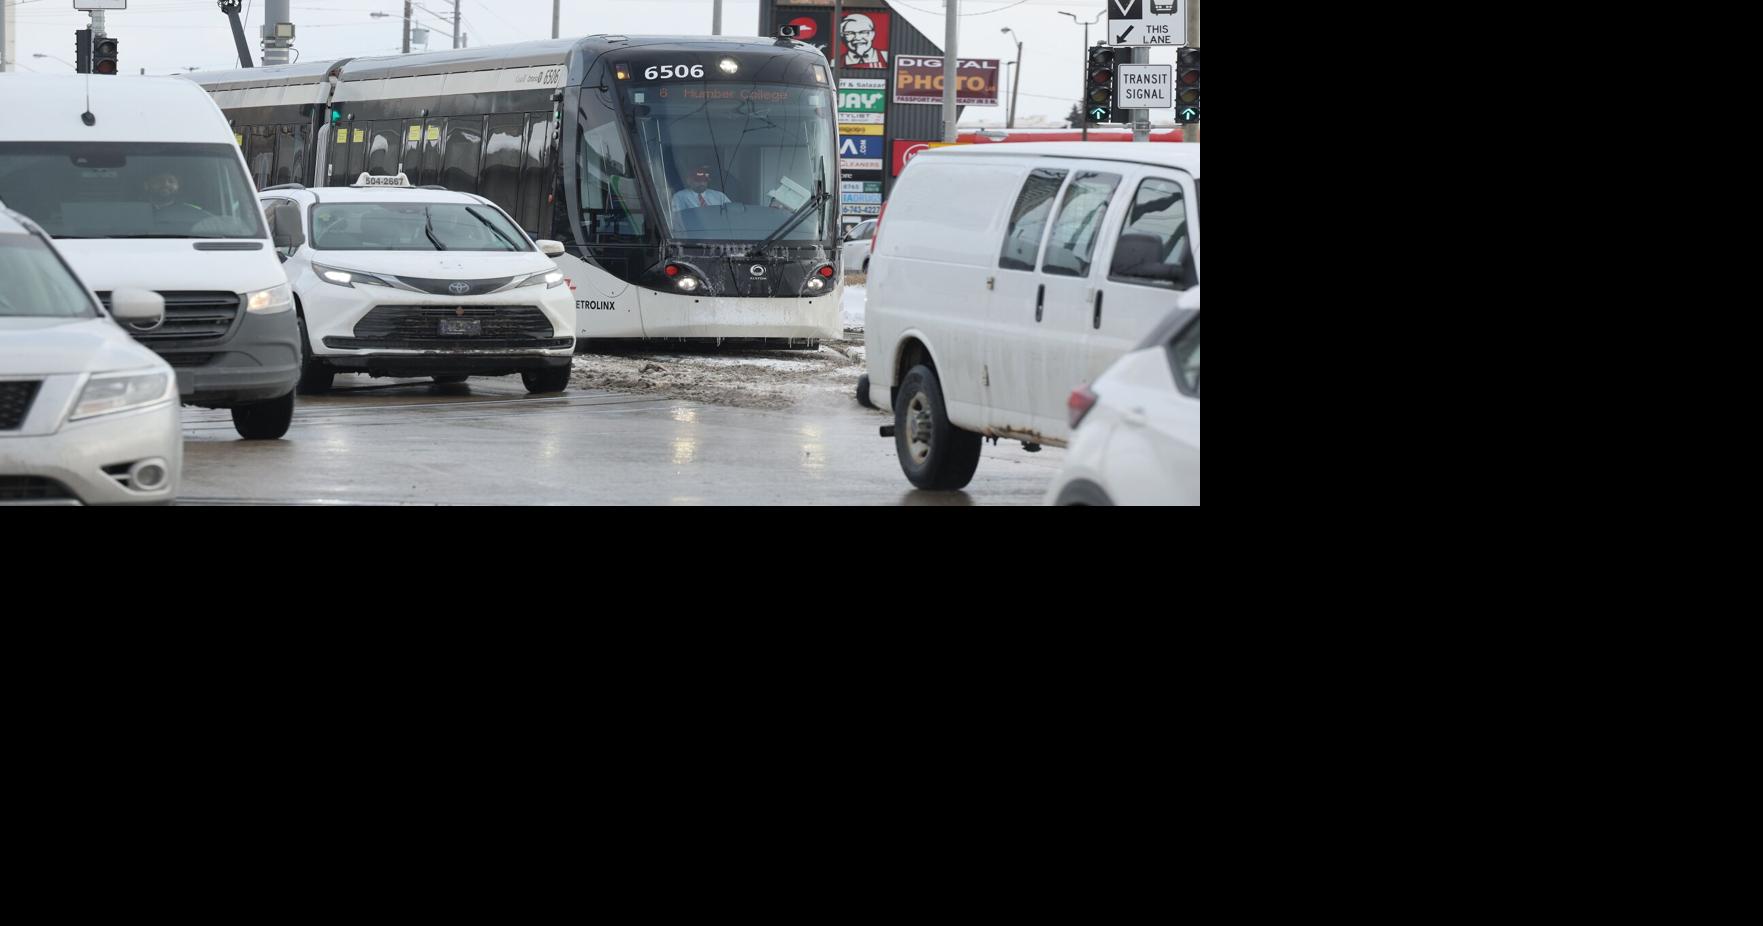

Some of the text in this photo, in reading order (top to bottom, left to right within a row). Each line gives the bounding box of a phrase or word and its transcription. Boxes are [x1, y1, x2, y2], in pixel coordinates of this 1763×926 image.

[1146, 25, 1169, 33] THIS
[1143, 36, 1171, 44] LANE
[899, 58, 997, 69] DIGTAL
[644, 64, 705, 80] 6506
[1124, 74, 1167, 84] TRANSIT
[1126, 89, 1164, 99] SIGNAL
[365, 177, 404, 186] 504-2667
[575, 300, 615, 310] ETROLINX
